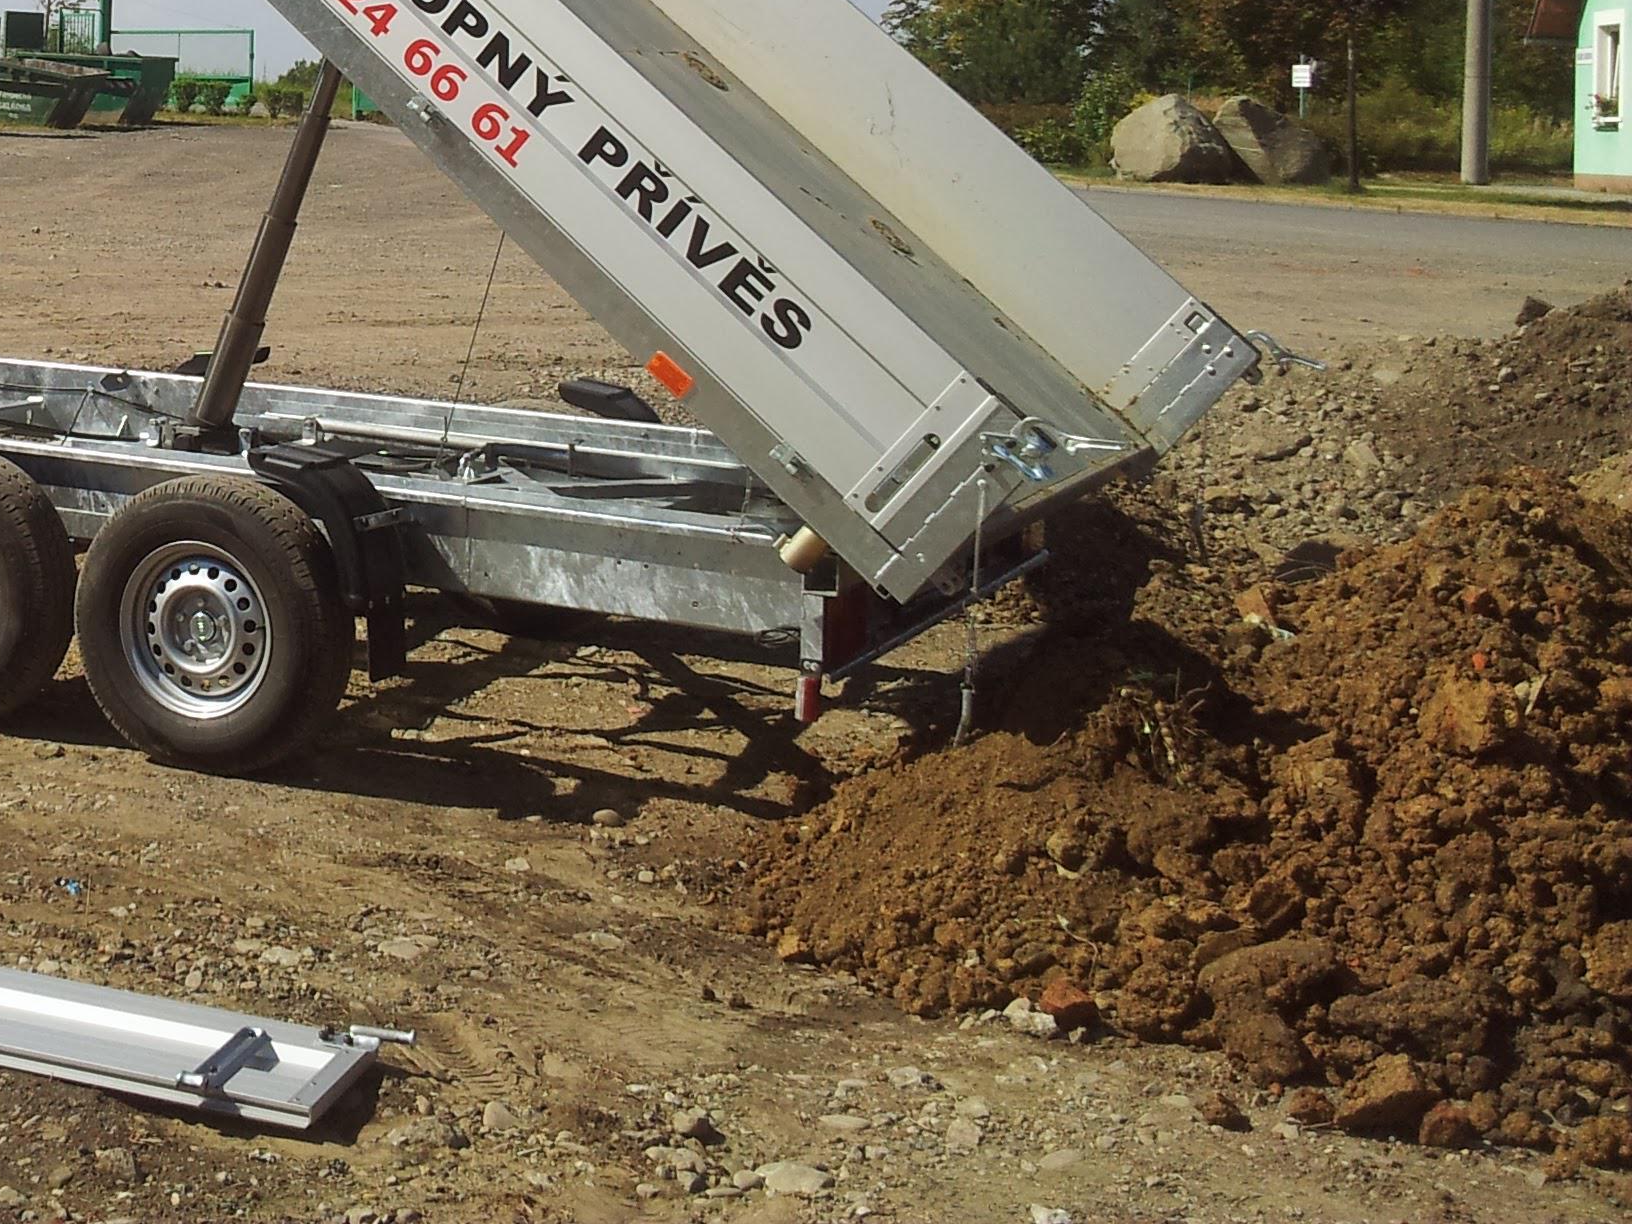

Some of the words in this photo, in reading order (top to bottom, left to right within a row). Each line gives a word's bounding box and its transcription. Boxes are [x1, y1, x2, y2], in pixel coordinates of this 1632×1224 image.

[402, 39, 468, 103] 66
[471, 102, 533, 169] 61
[578, 125, 813, 350] PŘÍVĚS
